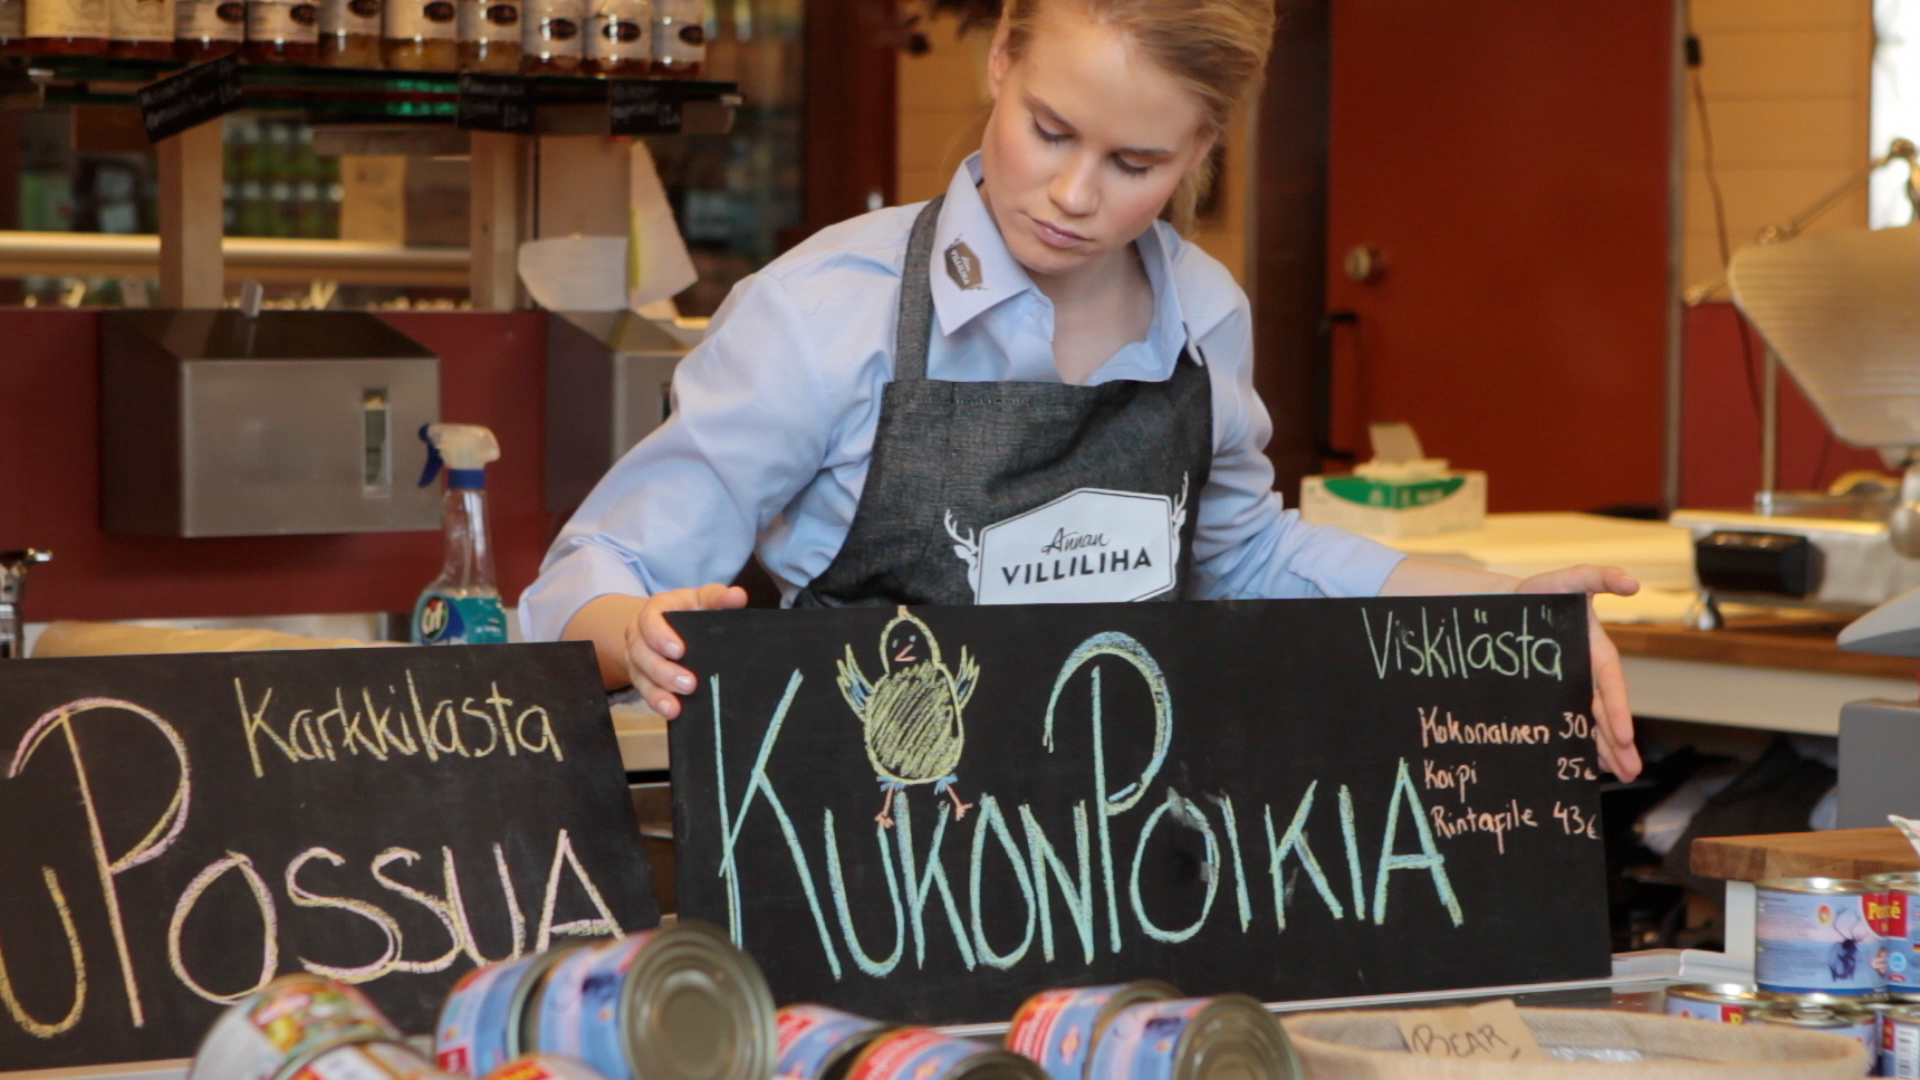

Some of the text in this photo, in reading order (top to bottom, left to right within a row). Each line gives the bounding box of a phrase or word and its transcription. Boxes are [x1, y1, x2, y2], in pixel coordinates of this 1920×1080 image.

[1041, 526, 1111, 555] Annan
[1002, 547, 1152, 586] VILLILIHA
[1361, 605, 1562, 681] Viskilästä
[234, 669, 564, 777] Karkkilasta
[1417, 706, 1550, 748] Kokonainen
[1424, 758, 1477, 803] Koipi
[1557, 757, 1597, 780] 25€
[1431, 799, 1538, 855] Rintafile
[1553, 801, 1601, 839] 43€
